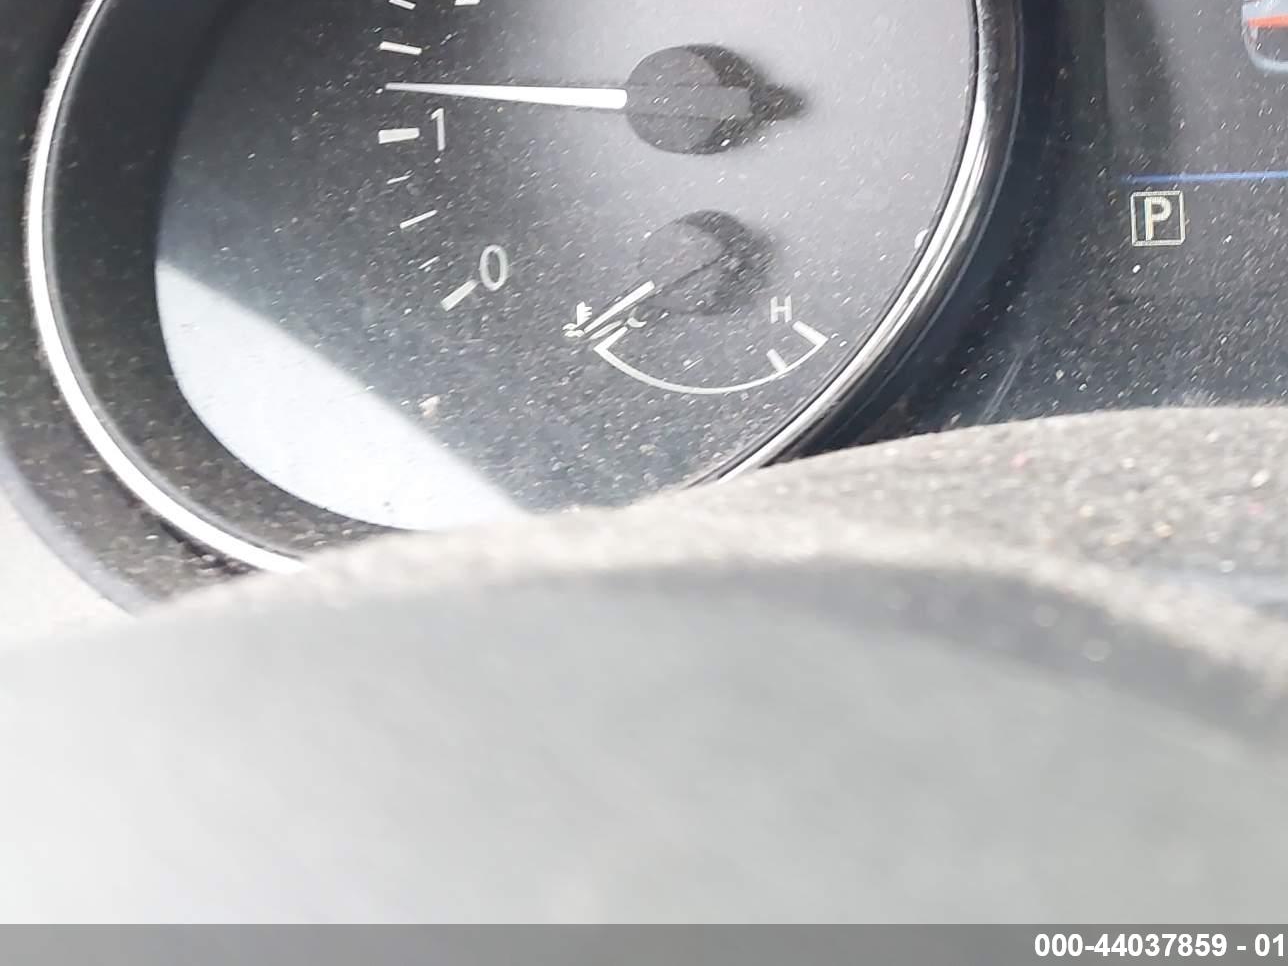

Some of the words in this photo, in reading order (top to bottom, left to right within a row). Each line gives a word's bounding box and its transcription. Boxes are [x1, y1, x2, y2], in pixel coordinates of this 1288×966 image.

[430, 107, 446, 152] 1
[1144, 197, 1172, 241] P
[480, 245, 508, 291] 0
[770, 296, 792, 324] H
